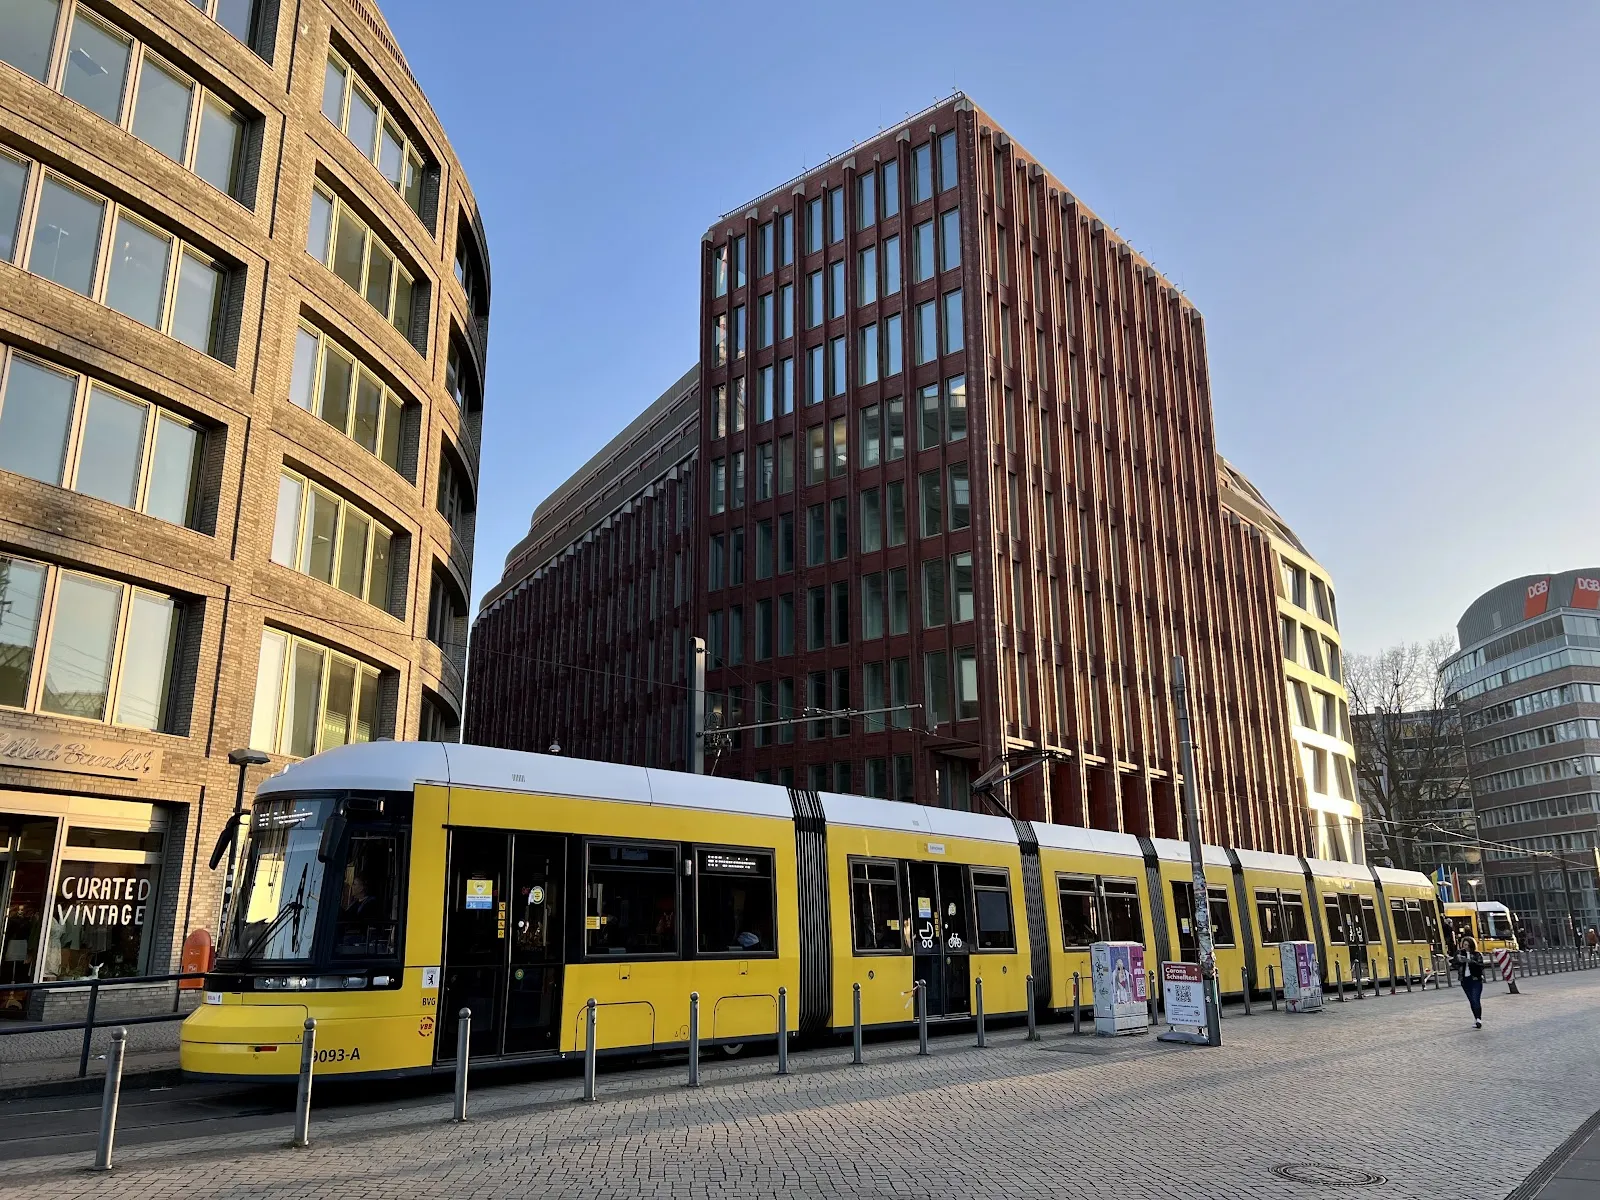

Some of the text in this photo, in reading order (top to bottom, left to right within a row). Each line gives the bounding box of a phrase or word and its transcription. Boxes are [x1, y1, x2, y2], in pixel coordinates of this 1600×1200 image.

[1527, 580, 1549, 599] DGB
[1577, 577, 1600, 592] DGB
[61, 876, 152, 901] CURATED
[57, 903, 147, 926] VINTAGE
[422, 997, 436, 1006] BVG
